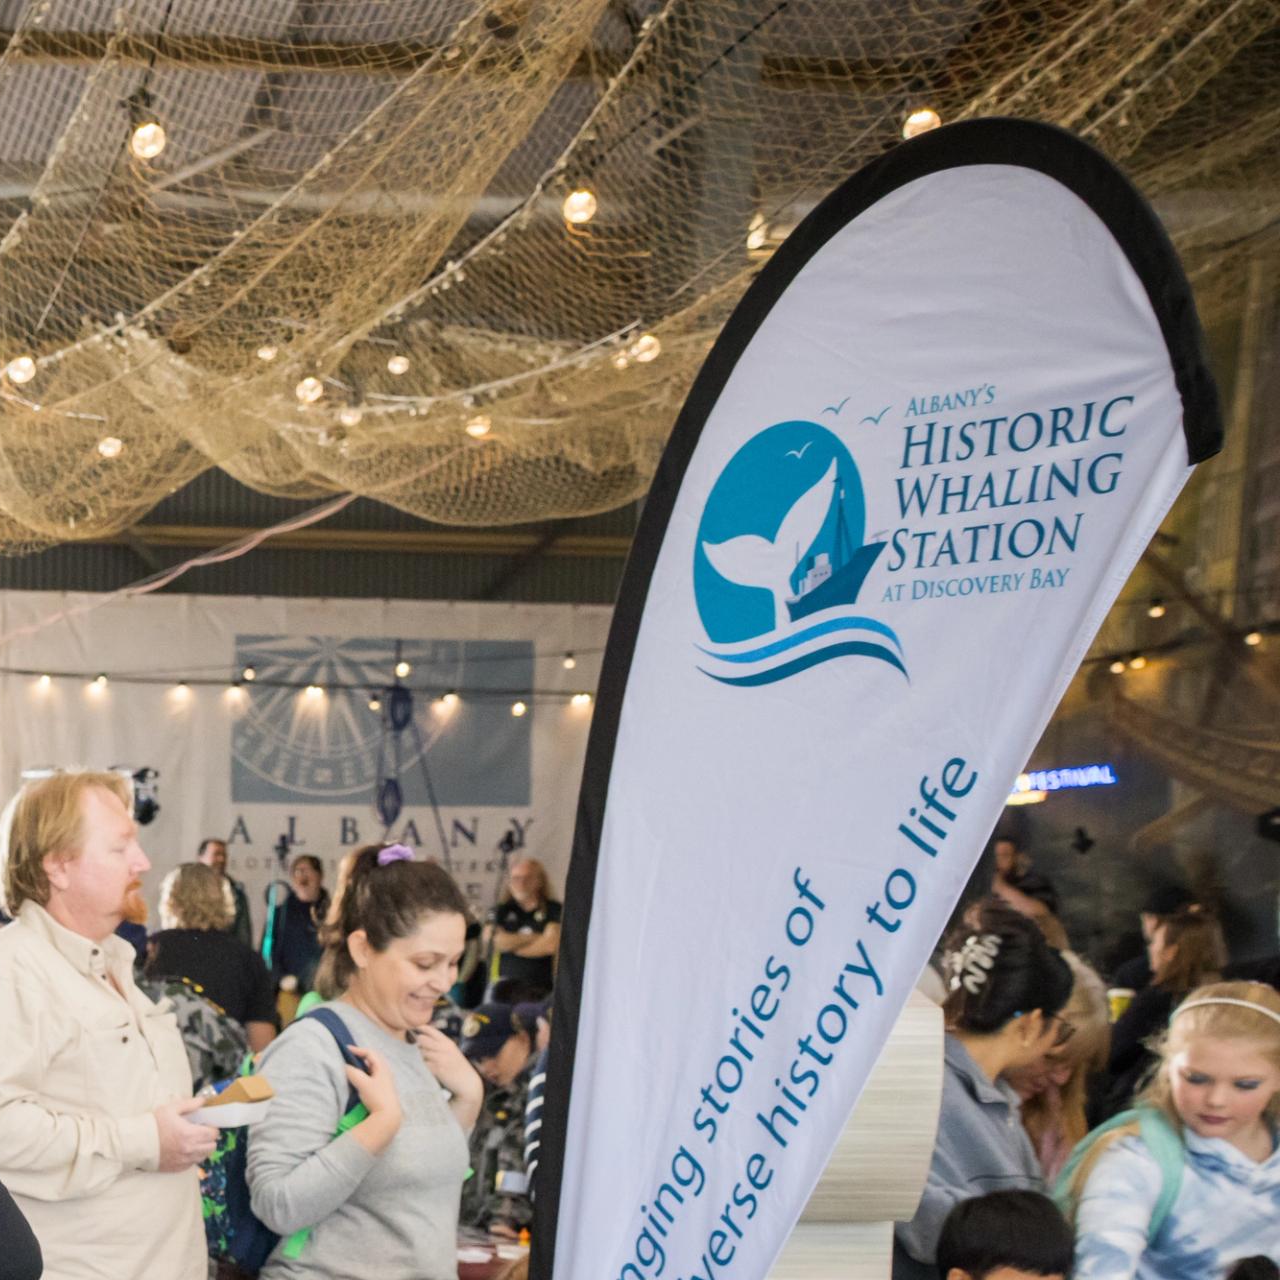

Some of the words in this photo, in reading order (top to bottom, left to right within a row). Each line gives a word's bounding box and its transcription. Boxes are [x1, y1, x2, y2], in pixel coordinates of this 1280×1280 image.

[899, 395, 1135, 469] HISTORIC
[904, 383, 996, 418] ALBANY'S
[894, 453, 1123, 520] WHALING
[887, 512, 1085, 572] STATION
[882, 583, 906, 603] AT
[911, 571, 1025, 601] DISCOVERY
[1029, 567, 1070, 590] BAY
[757, 939, 885, 1150] history
[866, 867, 917, 936] to
[897, 755, 980, 860] life
[692, 953, 792, 1143] stories
[785, 867, 827, 946] of
